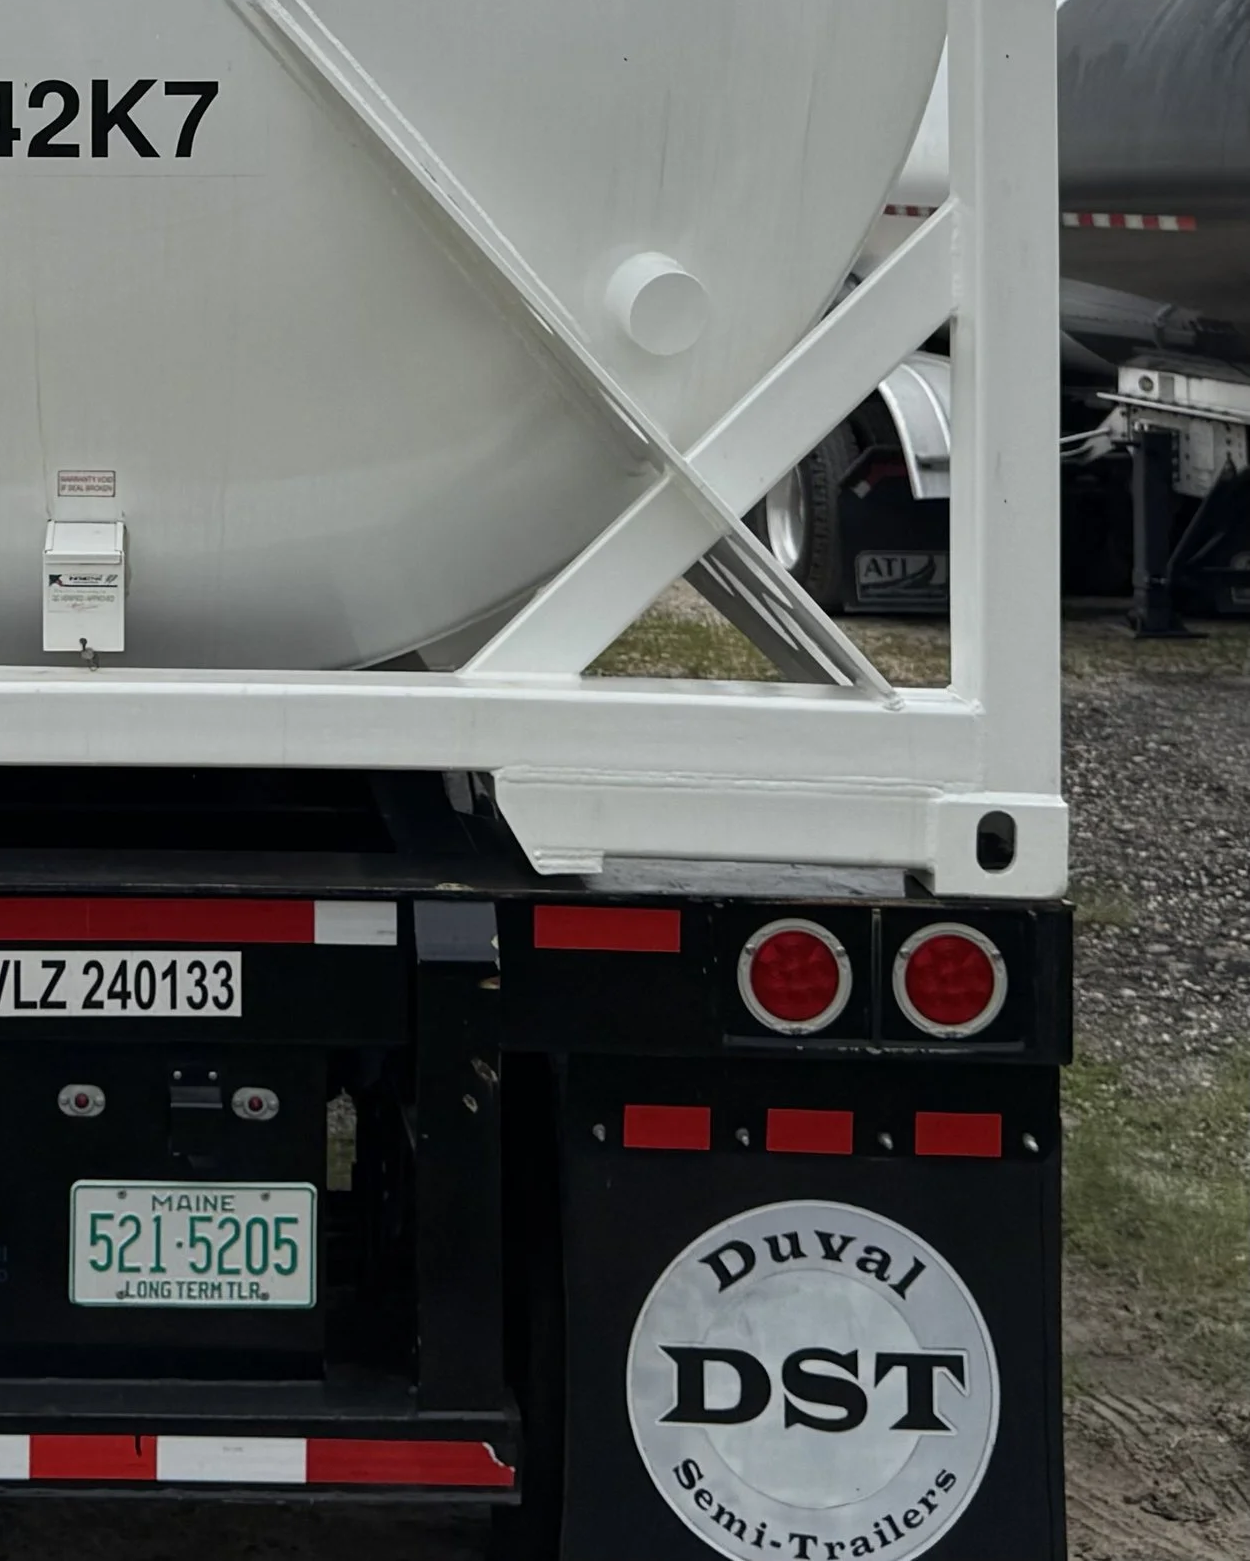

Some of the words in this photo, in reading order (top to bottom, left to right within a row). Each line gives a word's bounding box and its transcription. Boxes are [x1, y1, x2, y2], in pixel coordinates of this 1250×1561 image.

[81, 959, 235, 1011] 240133
[151, 1194, 235, 1212] MAINE
[125, 1280, 171, 1299] LONG
[176, 1281, 222, 1299] TERM
[227, 1282, 261, 1300] TLR
[697, 1229, 927, 1301] Duval
[658, 1344, 966, 1433] DST
[673, 1457, 957, 1561] Semi-Trailers
